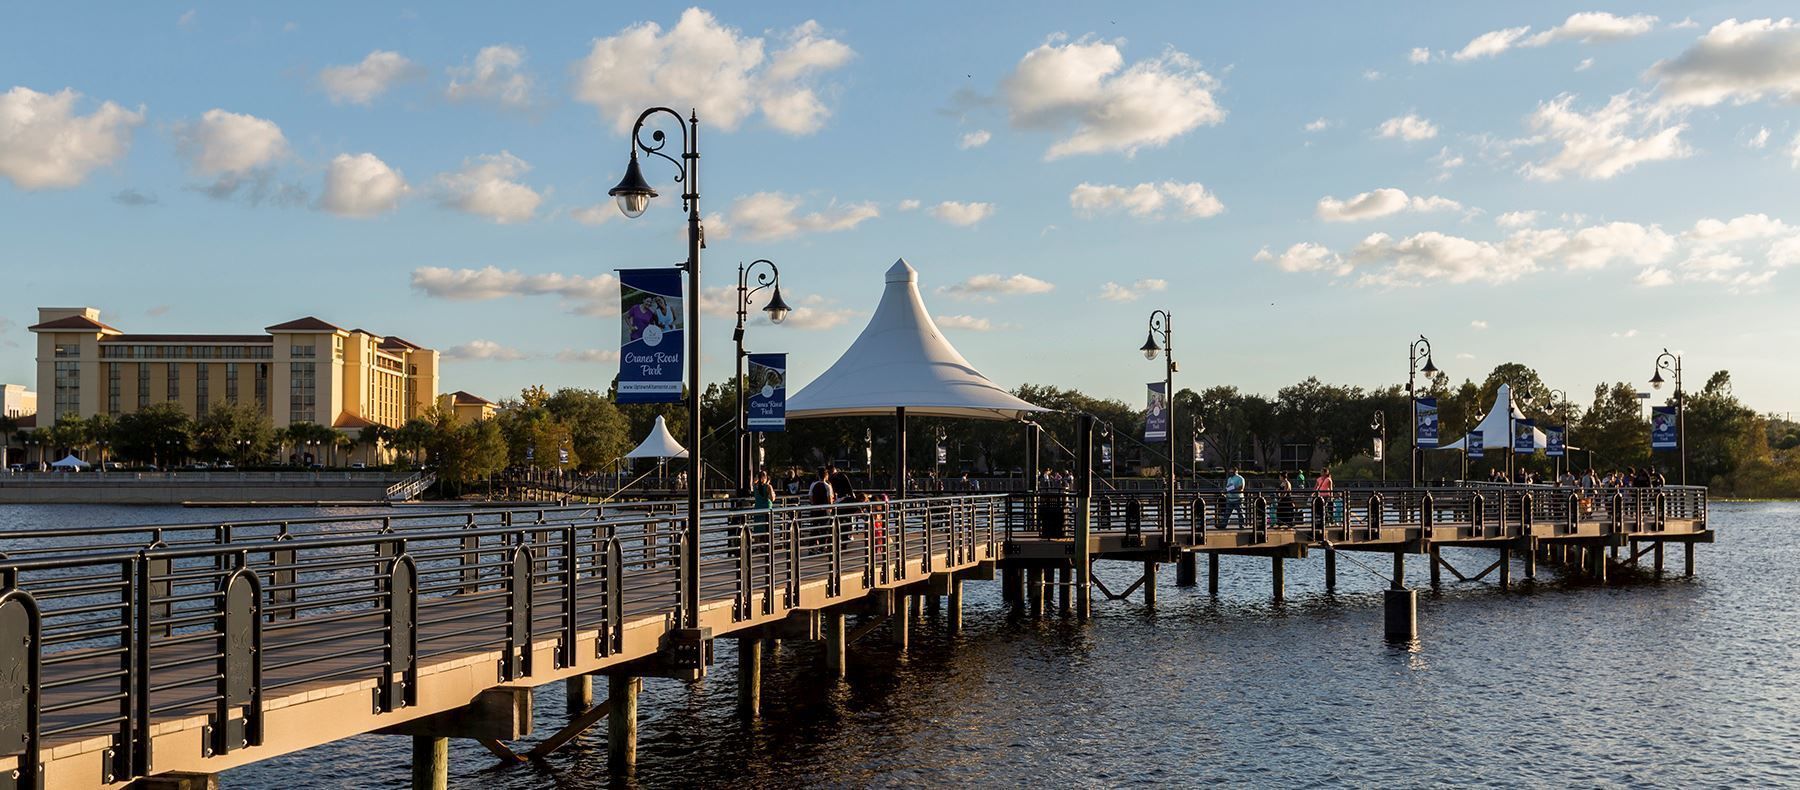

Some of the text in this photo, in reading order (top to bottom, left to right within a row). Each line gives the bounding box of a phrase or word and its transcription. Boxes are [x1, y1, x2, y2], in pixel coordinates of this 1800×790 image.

[625, 352, 679, 363] Cranes Roost
[640, 364, 662, 376] Park
